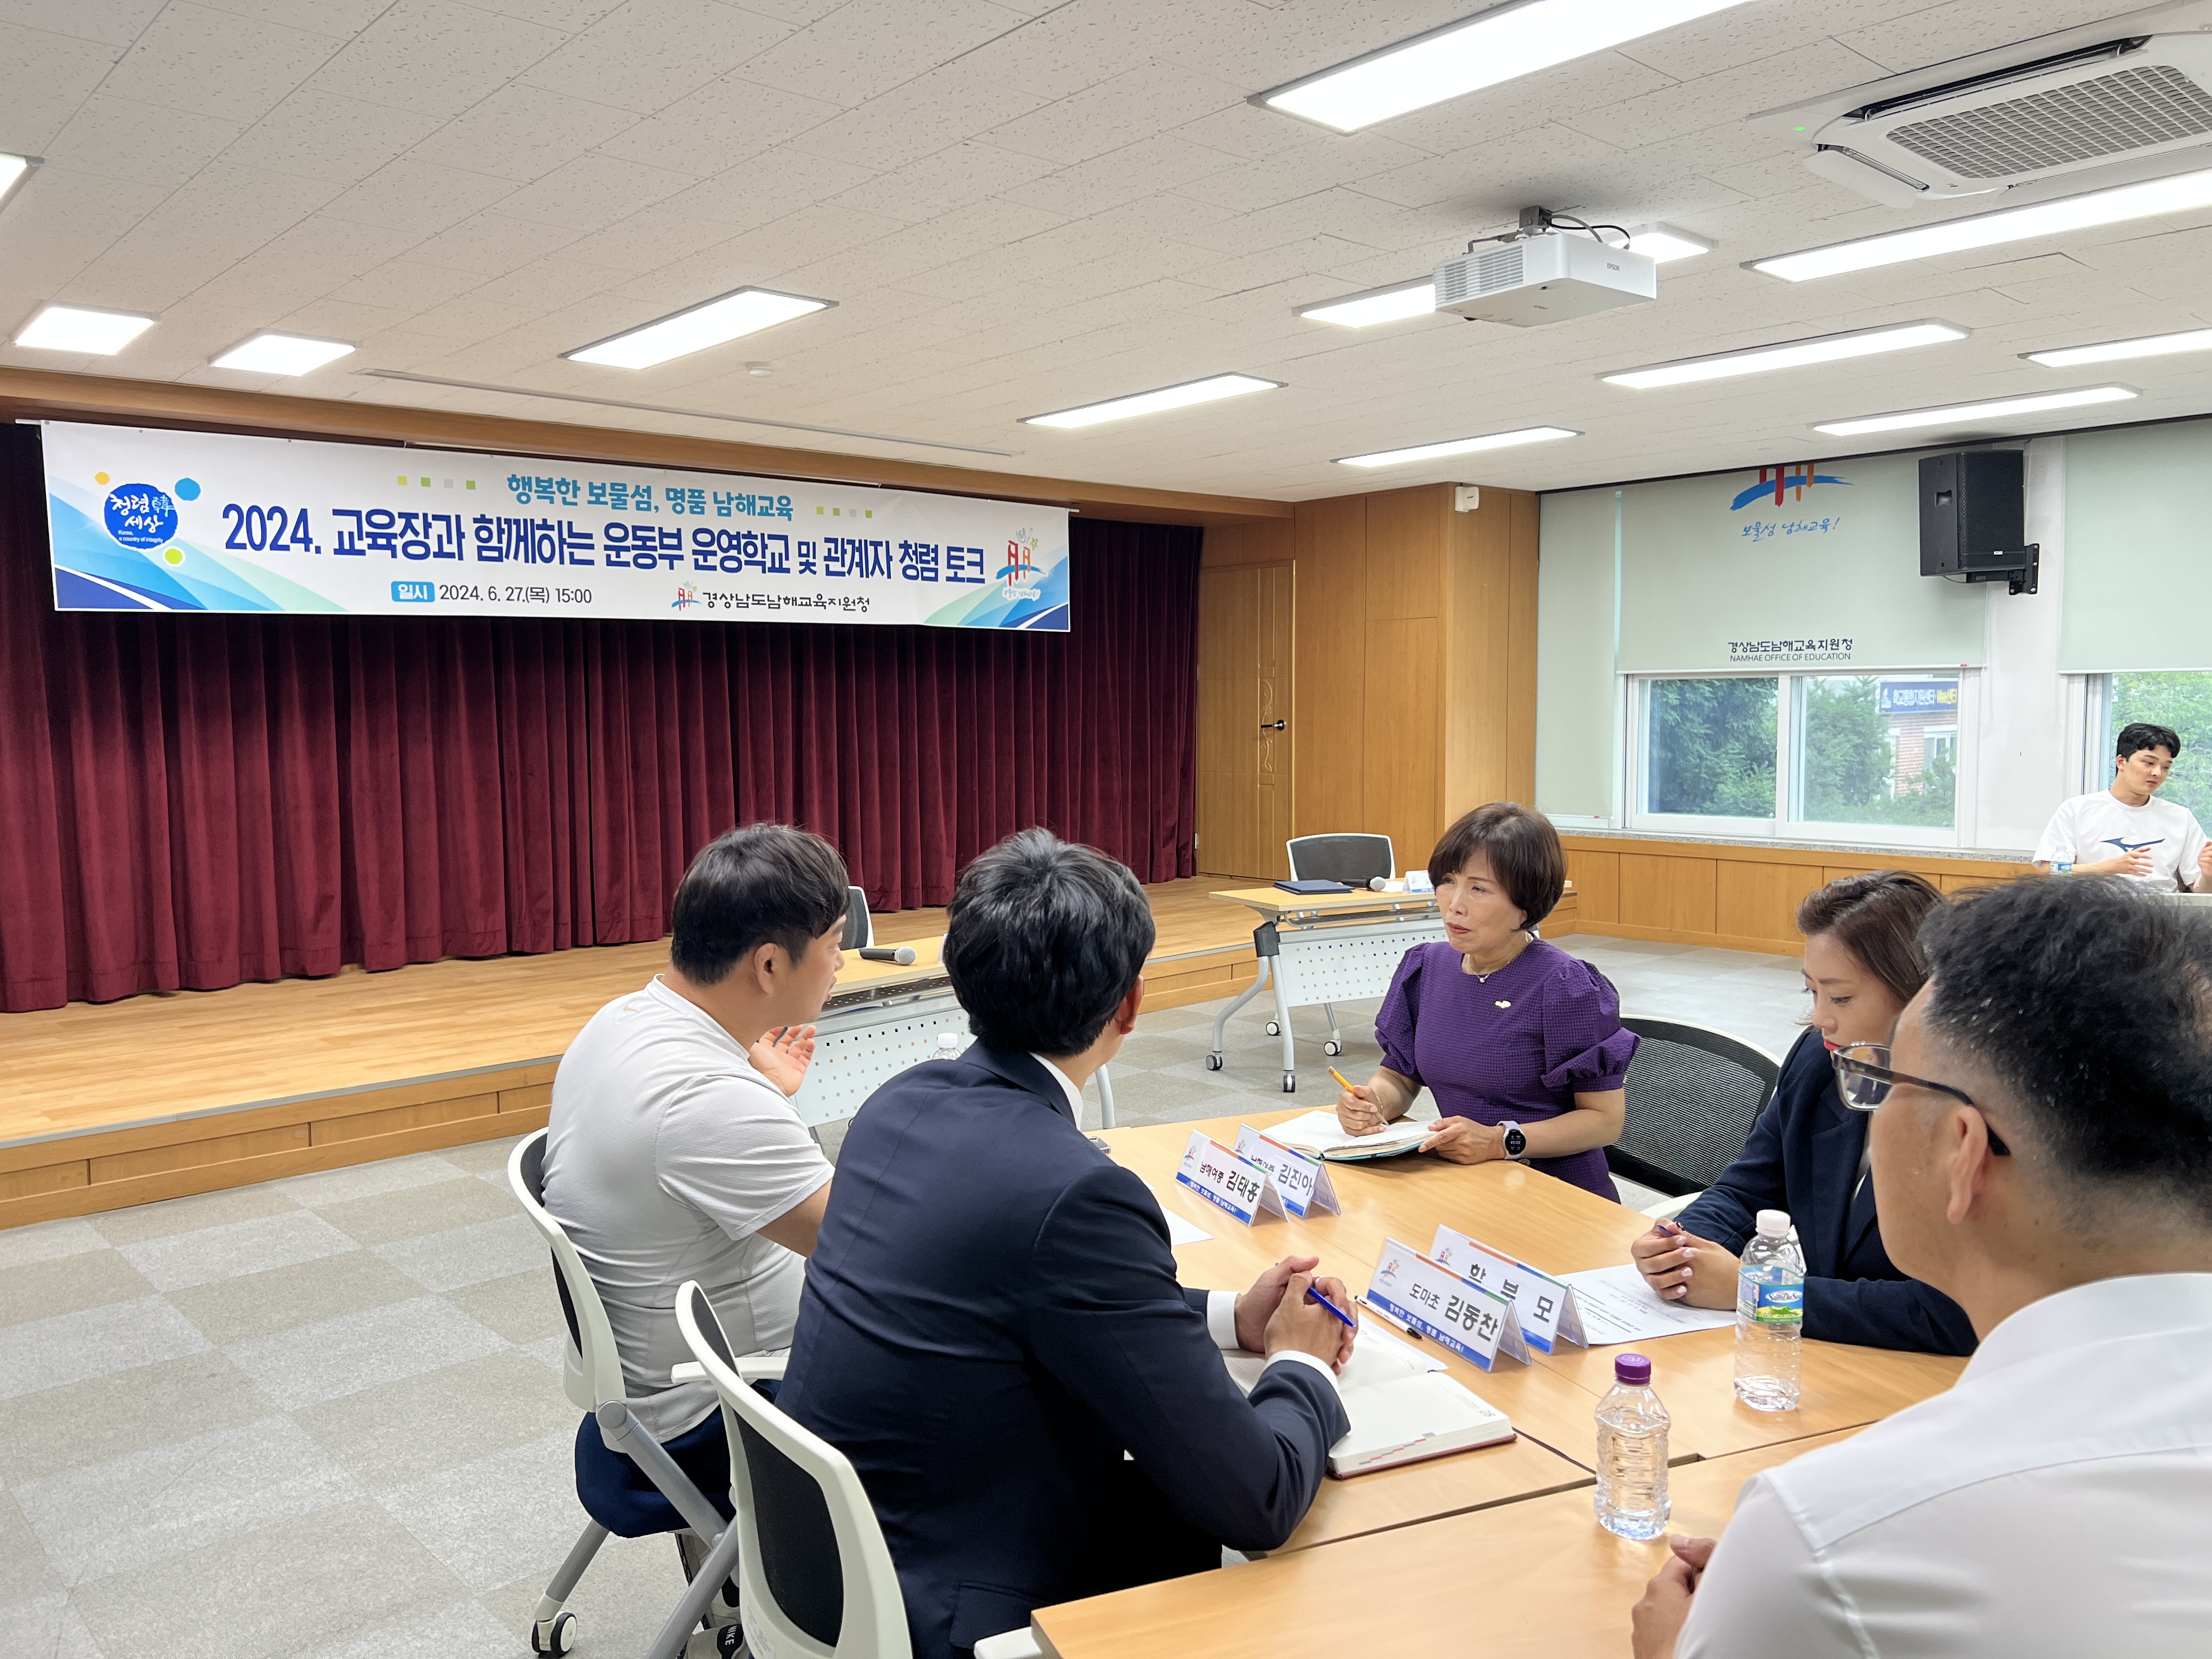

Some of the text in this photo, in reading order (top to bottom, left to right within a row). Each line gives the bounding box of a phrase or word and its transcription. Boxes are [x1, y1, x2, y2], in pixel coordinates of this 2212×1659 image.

[1607, 262, 1620, 271] EPSON
[506, 473, 794, 522] 행복한 보물섬, 명품 남해교육
[125, 515, 163, 533] 세상
[222, 503, 985, 584] 2024. 교육장과 함께하는 운동부 운영학교 및 관계자 청렴 토크
[398, 584, 592, 604] 일시 2024. 6. 27.(목) 15:00
[702, 592, 870, 613] 경상남도남해교육지원청
[1728, 638, 1853, 653] 경상남도남해교육지원청
[1730, 654, 1763, 662] NAMHAE
[1764, 653, 1791, 662] OFFICE
[1804, 652, 1850, 661] EDUCATION
[1200, 1161, 1261, 1203] 남해여중 김태홍
[1278, 1164, 1313, 1197] 김진아
[1409, 1283, 1498, 1342] 도마초 김동찬
[1533, 1295, 1554, 1323] 모
[725, 1625, 738, 1646] NIKE
